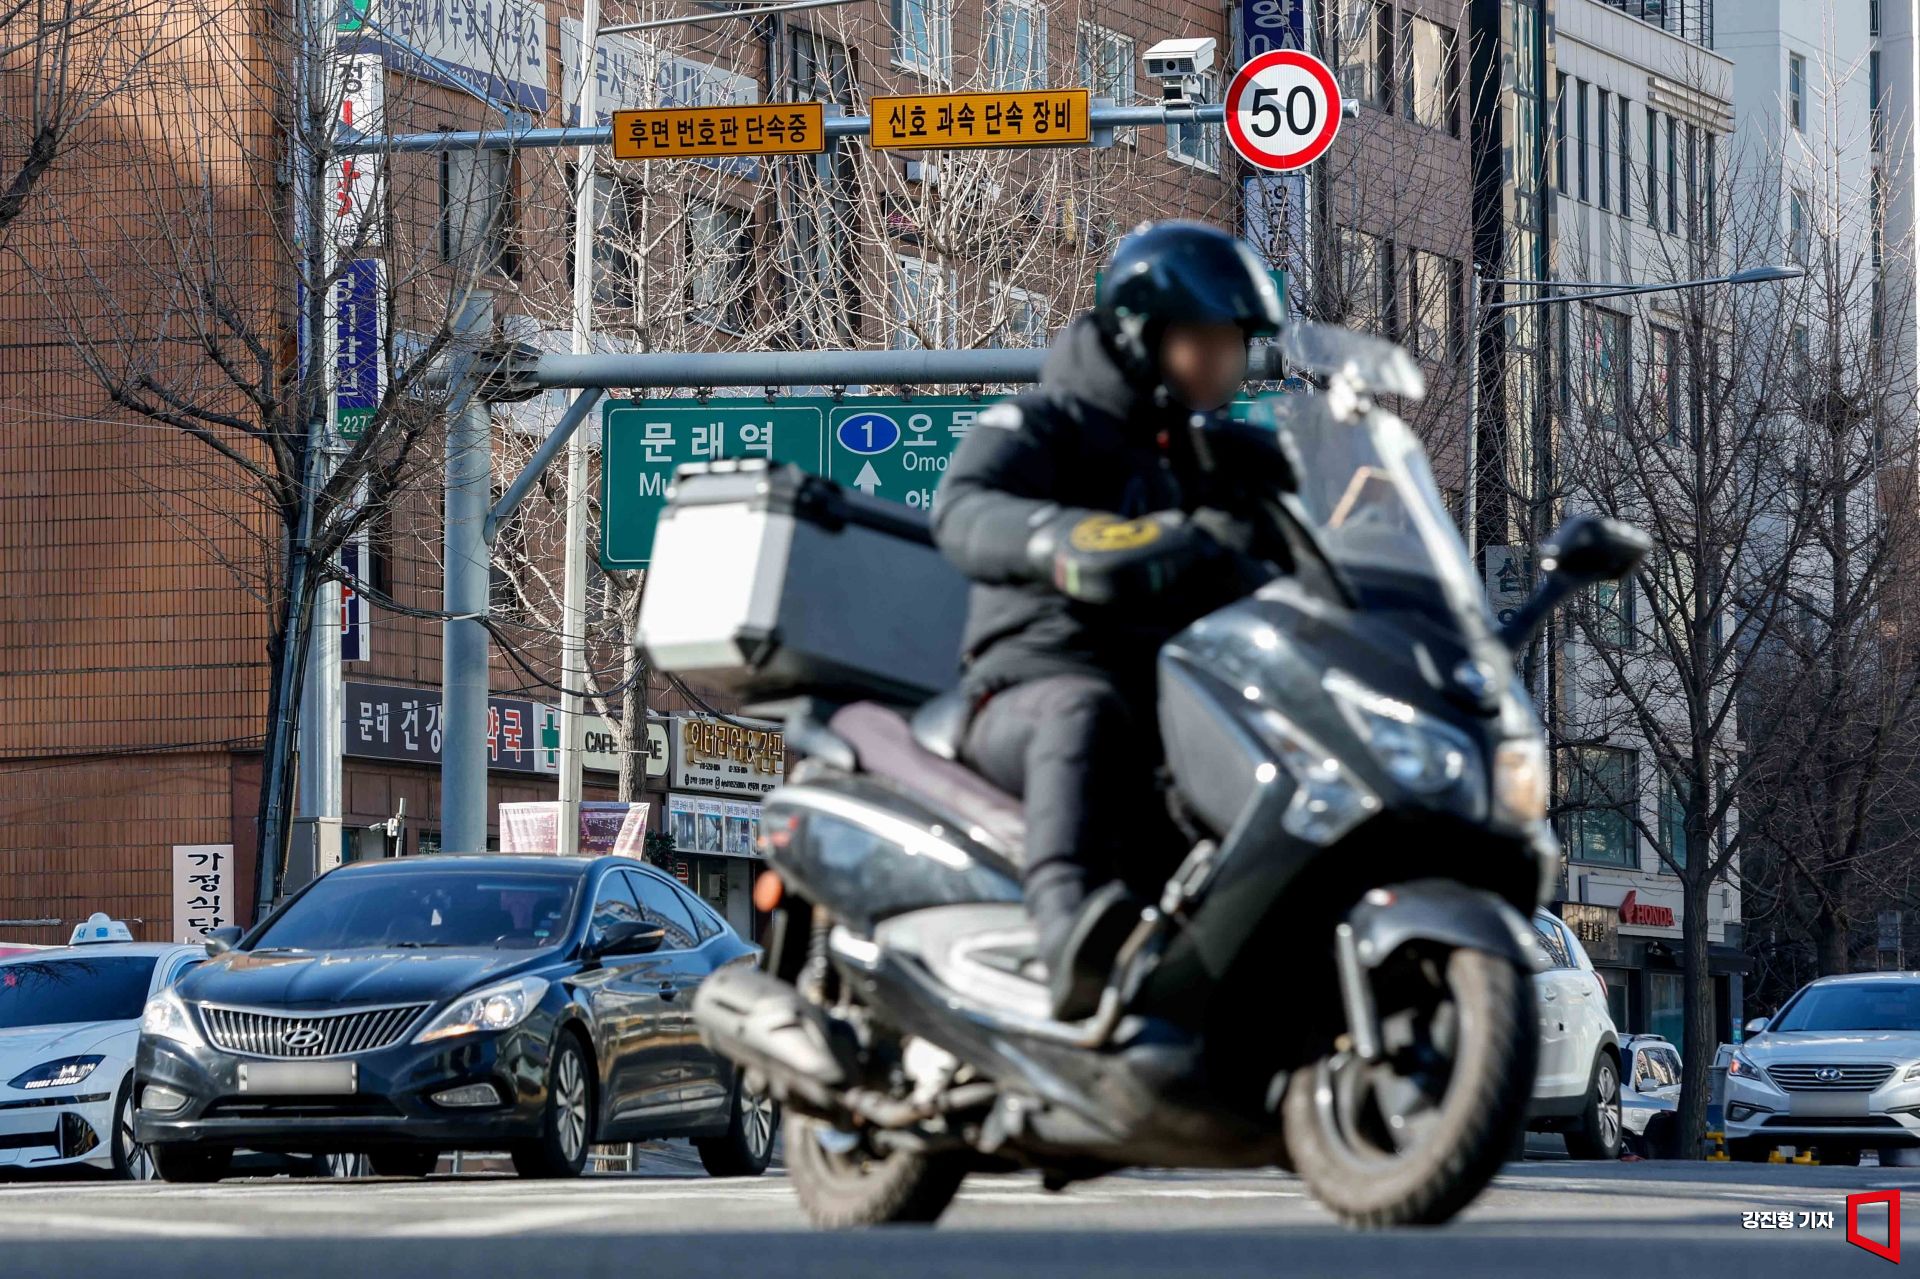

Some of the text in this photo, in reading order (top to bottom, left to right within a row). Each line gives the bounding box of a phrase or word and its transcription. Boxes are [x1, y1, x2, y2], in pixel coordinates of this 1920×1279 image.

[888, 98, 1071, 138] 신호 과속 단속 장비
[1251, 85, 1316, 137] 50
[629, 114, 807, 149] 후면 번호판 단속중
[640, 421, 773, 462] 문래역
[860, 420, 873, 448] 1
[359, 700, 522, 763] 문래 건강 약국
[187, 852, 224, 935] 가정식당
[1635, 904, 1675, 927] HONDA
